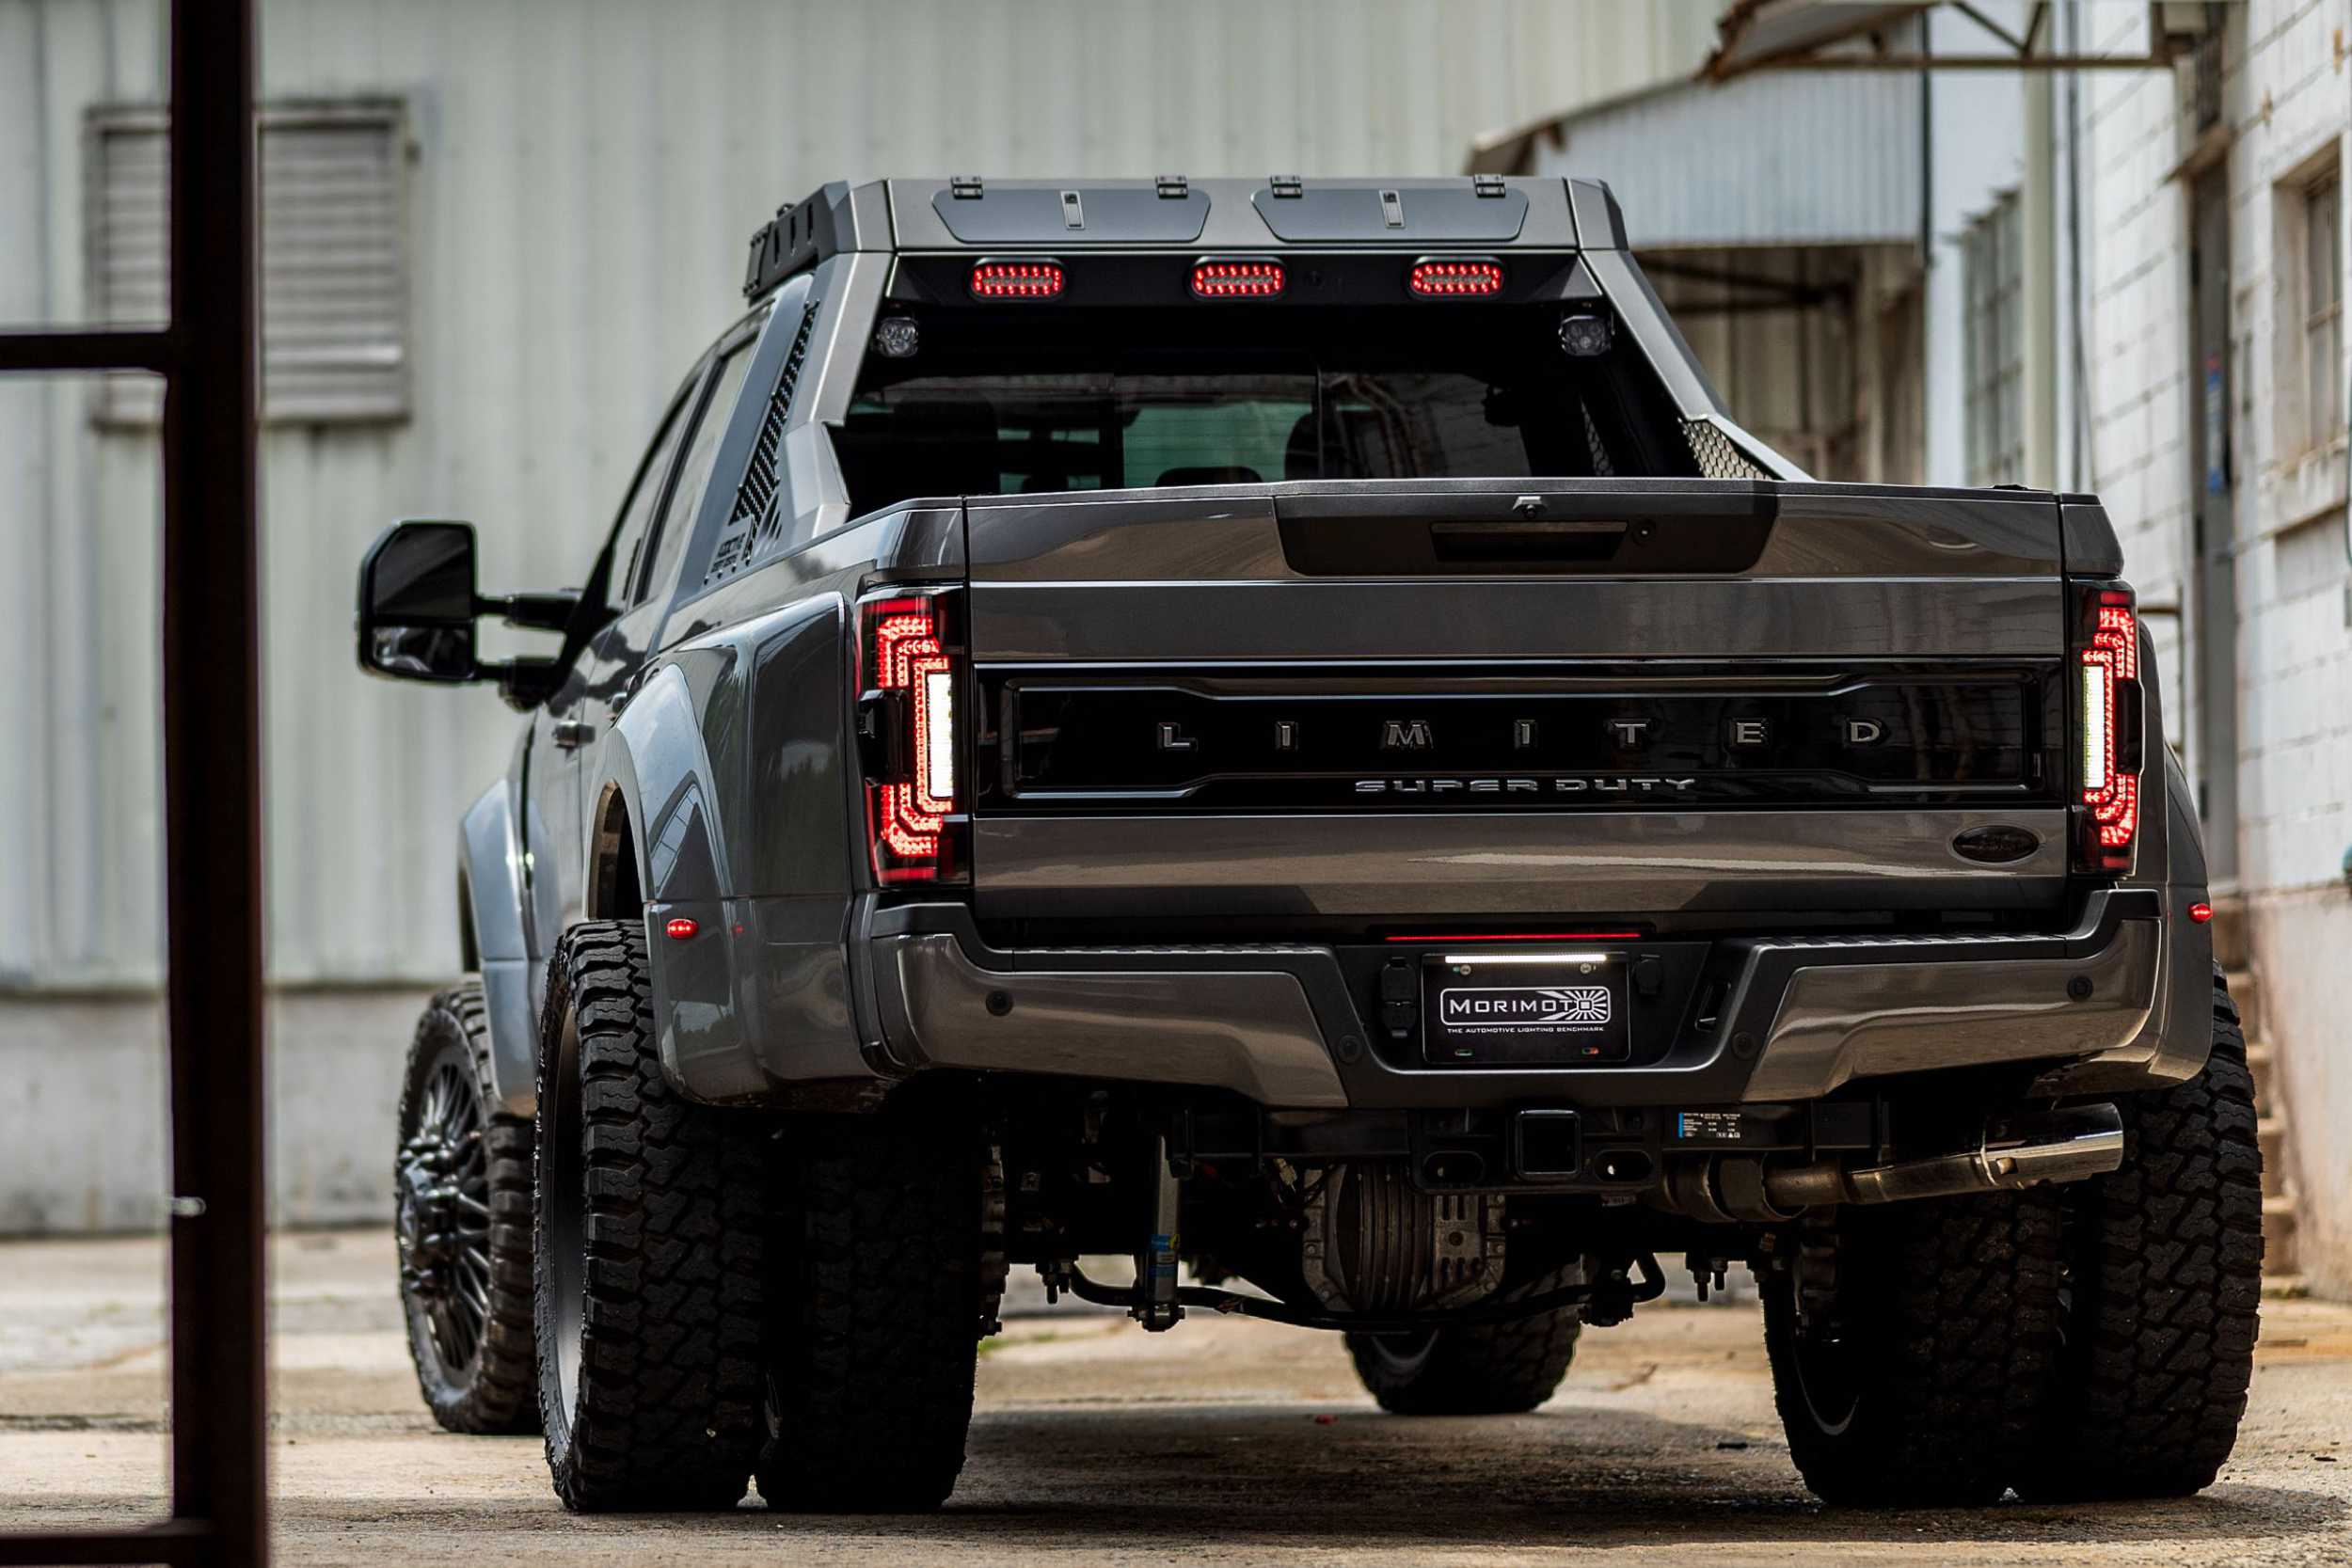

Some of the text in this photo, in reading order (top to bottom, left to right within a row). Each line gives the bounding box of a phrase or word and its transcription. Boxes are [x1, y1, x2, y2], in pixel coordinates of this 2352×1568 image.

[1160, 721, 1880, 749] LIMITED
[1355, 779, 1694, 791] SUPER DUTY
[1450, 999, 1595, 1014] MORIMOTO
